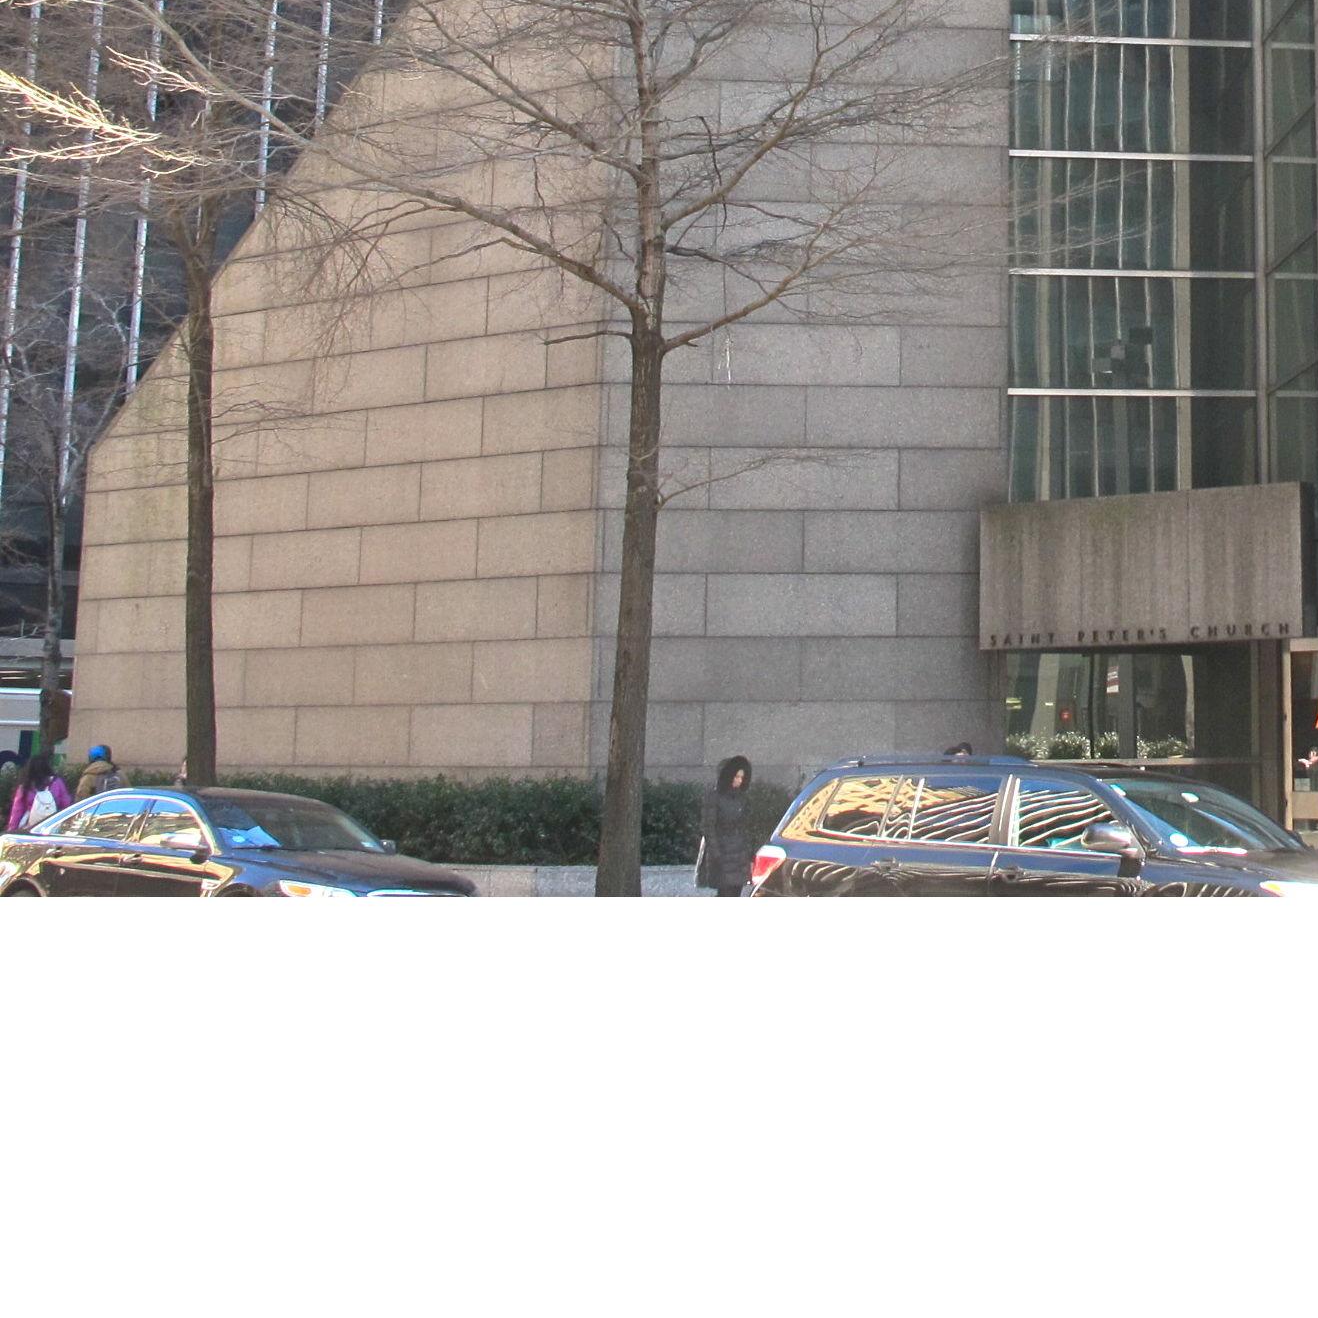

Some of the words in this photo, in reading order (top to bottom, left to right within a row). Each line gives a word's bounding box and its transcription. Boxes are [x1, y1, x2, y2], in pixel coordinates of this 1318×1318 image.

[990, 631, 1055, 647] SAINT
[1077, 627, 1168, 642] PETER'S
[1190, 622, 1290, 639] CHURCH
